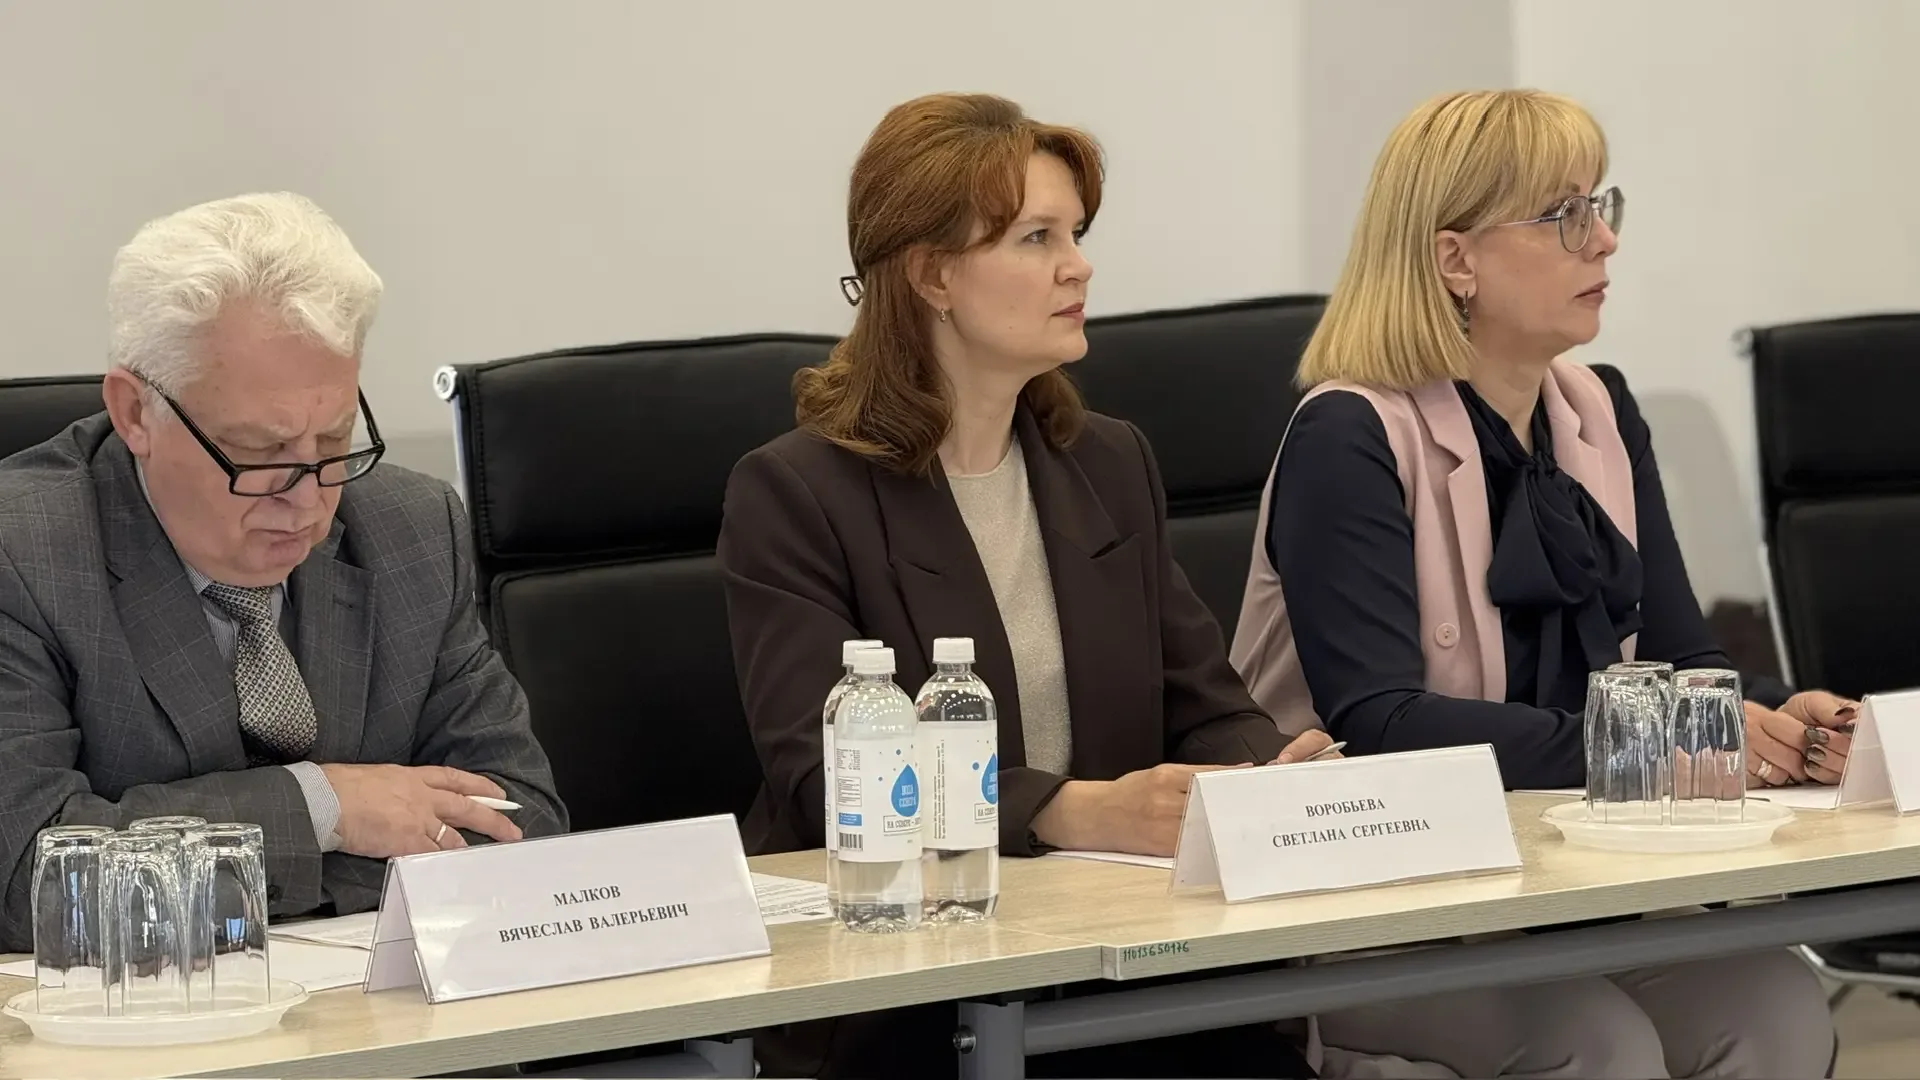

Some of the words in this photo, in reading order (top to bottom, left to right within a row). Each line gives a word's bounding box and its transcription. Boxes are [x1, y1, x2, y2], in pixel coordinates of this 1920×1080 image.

[1305, 798, 1386, 818] ВОРОБЬЕВА
[1272, 828, 1347, 848] СВЕТЛАНА
[1352, 818, 1431, 839] СЕРГЕЕВНА
[553, 885, 621, 907] МАЛКОВ
[499, 919, 583, 943] ВЯЧЕСЛАВ
[588, 902, 689, 931] ВАЛЕРЬЕВИЧ
